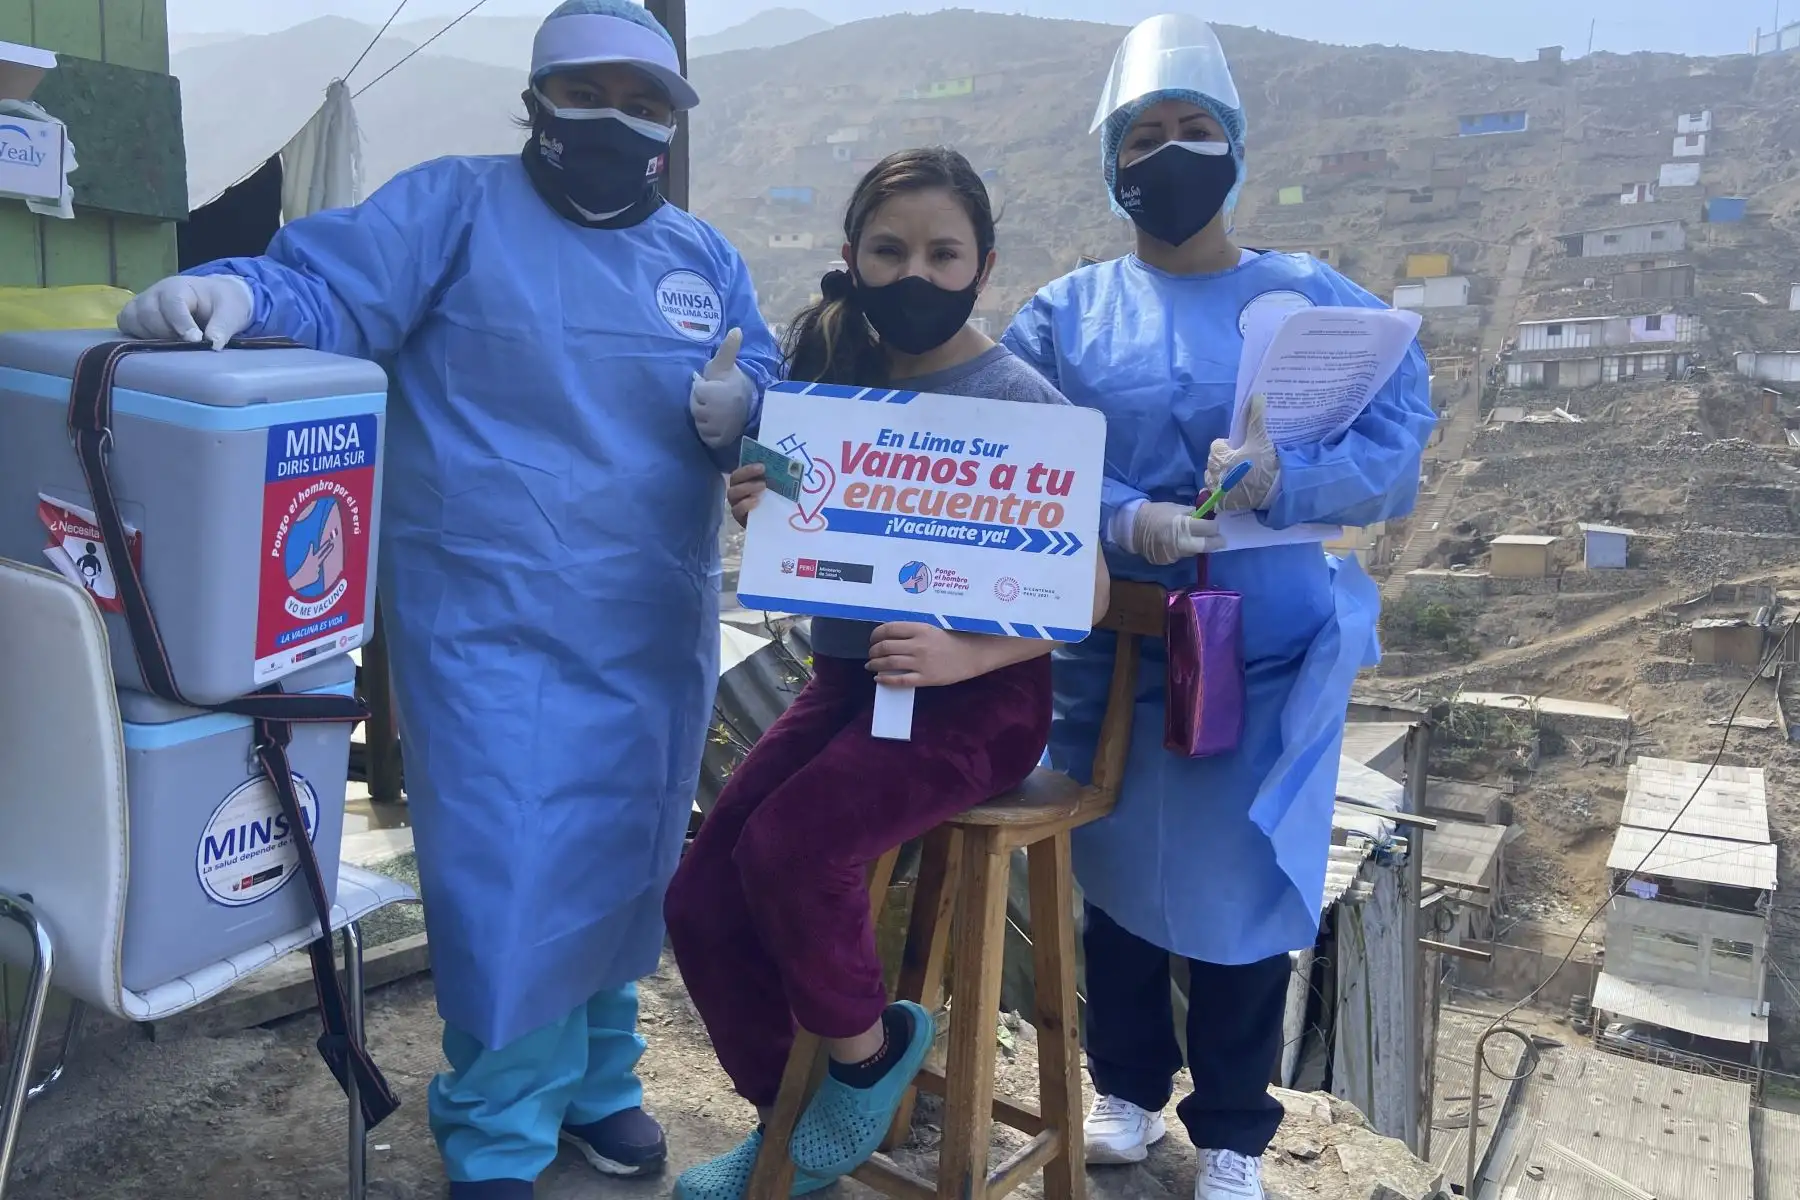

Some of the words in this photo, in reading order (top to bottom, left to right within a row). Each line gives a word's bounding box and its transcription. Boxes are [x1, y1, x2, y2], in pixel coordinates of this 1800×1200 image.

[661, 305, 681, 315] DIRIS
[682, 309, 702, 318] LIMA
[703, 311, 720, 319] SUR
[662, 291, 713, 309] MINSA
[286, 422, 360, 458] MINSA
[876, 428, 904, 448] En
[908, 431, 966, 454] Lima
[969, 437, 1009, 459] Sur
[277, 458, 310, 477] DIRIS
[312, 453, 341, 472] LIMA
[343, 450, 365, 466] SUR
[840, 440, 981, 487] Vamos
[989, 462, 1018, 490] a
[1027, 462, 1075, 497] tu
[298, 479, 334, 504] hombro
[332, 482, 349, 497] por
[346, 495, 356, 508] el
[288, 497, 298, 514] el
[843, 481, 1065, 529] encuentro
[350, 505, 362, 536] Perú
[884, 517, 976, 541] ¡Vacúnate
[981, 528, 1010, 546] ya!
[271, 514, 290, 558] Pongo
[798, 564, 815, 572] PERÚ
[935, 567, 956, 576] Pongo
[941, 575, 968, 583] hombro
[288, 599, 299, 613] YO
[299, 606, 312, 617] ME
[313, 582, 345, 615] VACUNO
[932, 581, 945, 589] por
[953, 583, 970, 591] Perú
[280, 634, 290, 644] LA
[291, 623, 319, 640] VACUNA
[319, 621, 329, 630] ES
[329, 615, 344, 627] VIDA
[202, 866, 213, 875] La
[214, 856, 238, 870] salud
[239, 843, 277, 861] depende
[277, 839, 289, 848] de
